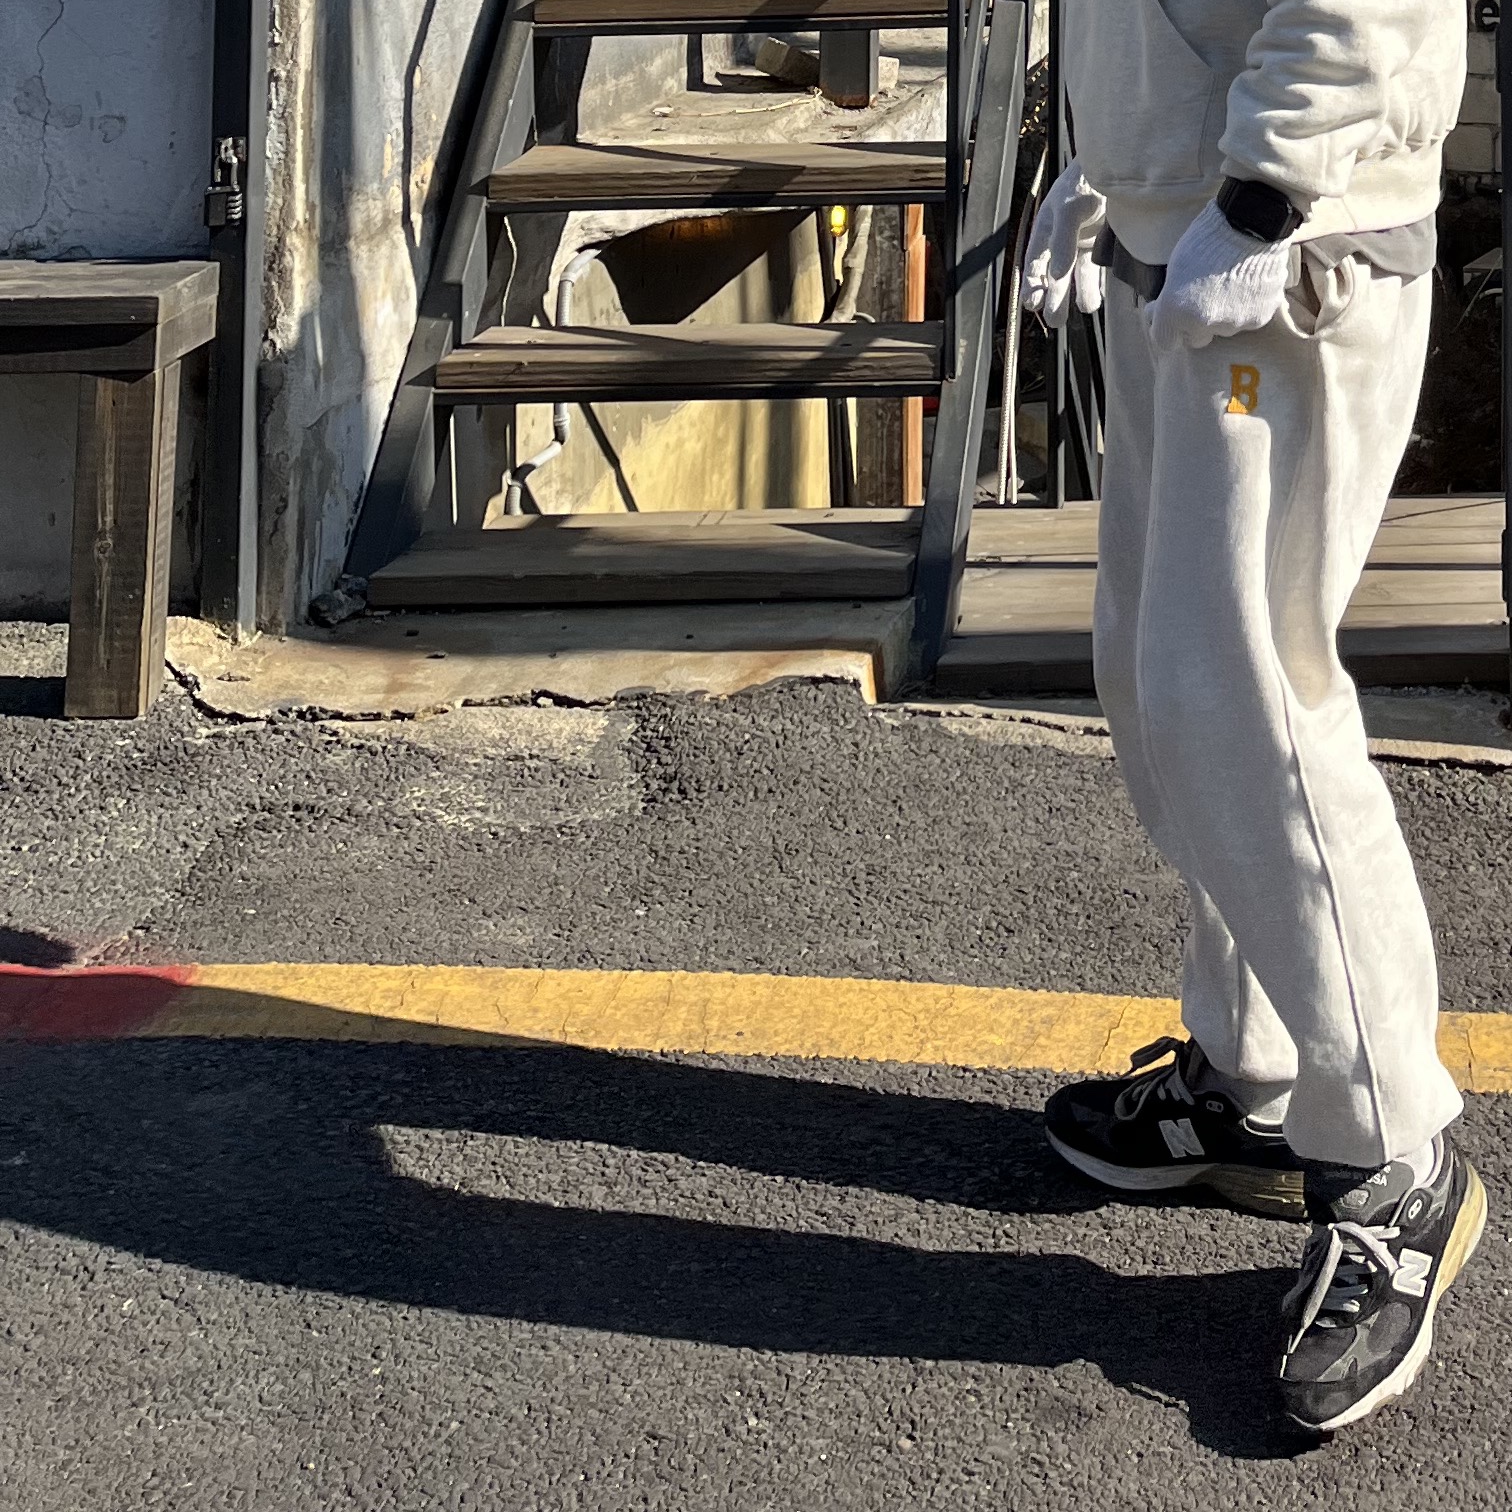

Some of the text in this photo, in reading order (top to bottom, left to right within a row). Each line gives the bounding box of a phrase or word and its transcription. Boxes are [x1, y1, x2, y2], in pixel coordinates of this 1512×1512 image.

[1226, 364, 1260, 415] B
[1158, 1117, 1205, 1158] N
[1392, 1247, 1433, 1298] N
